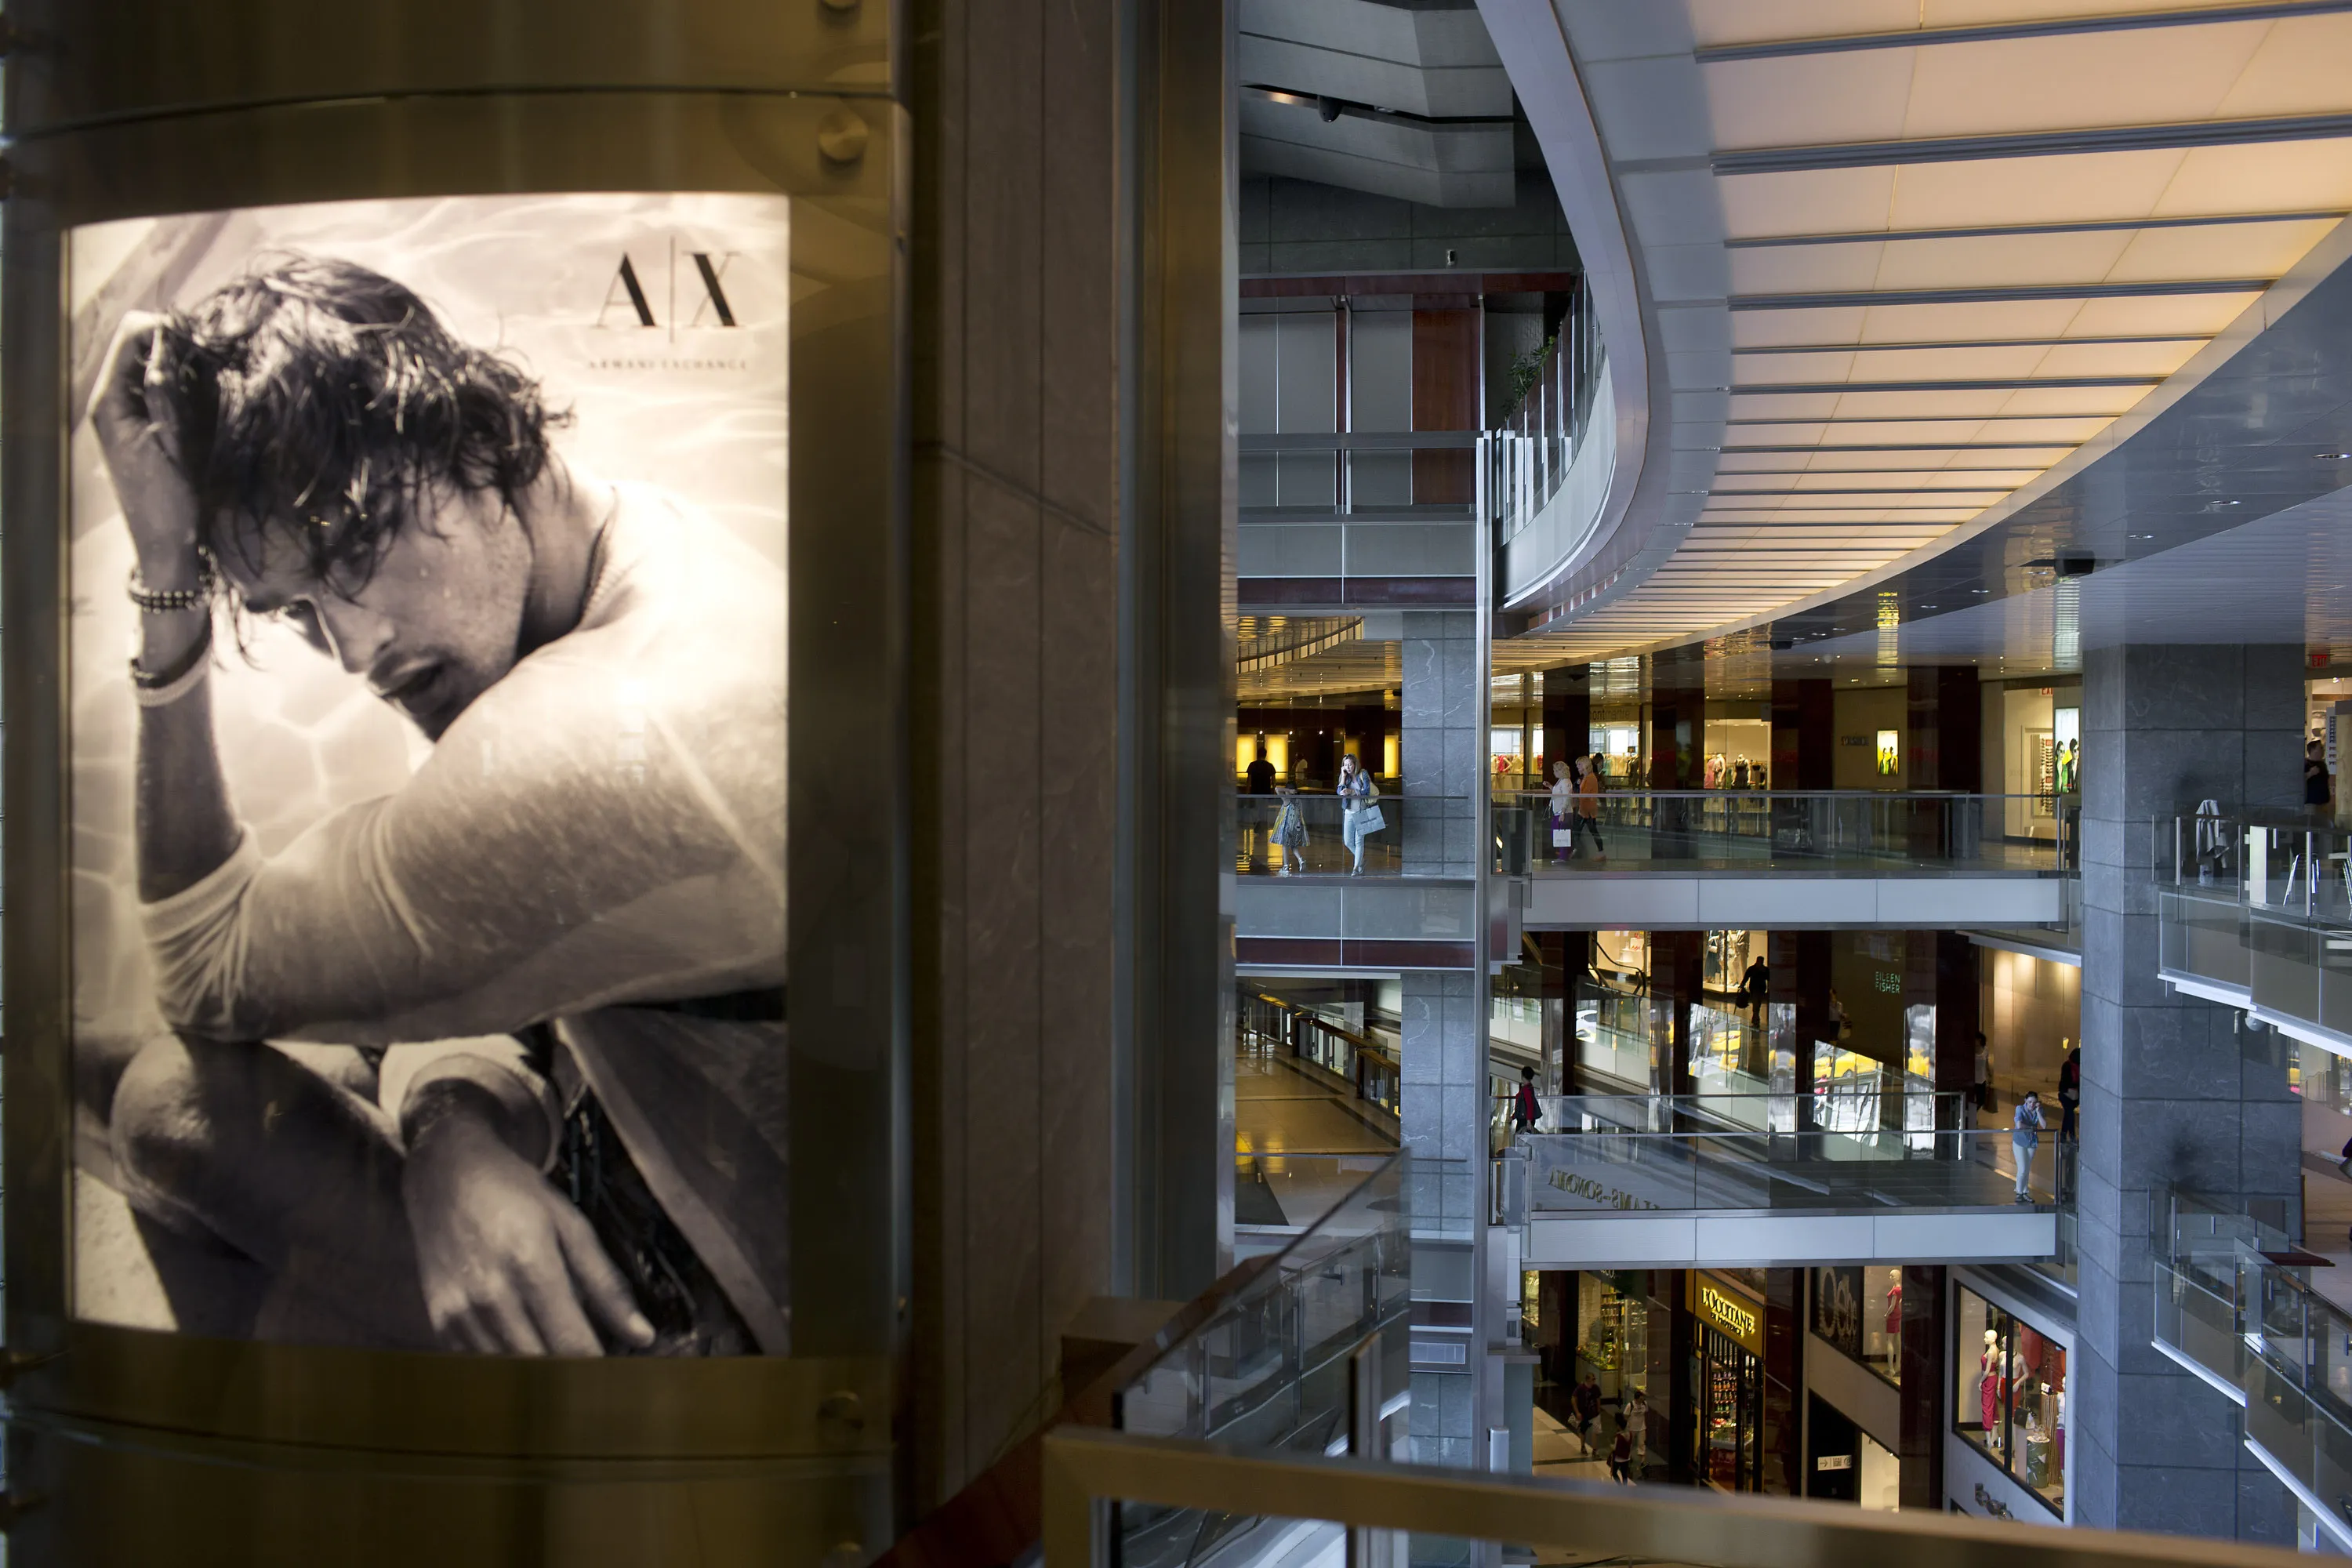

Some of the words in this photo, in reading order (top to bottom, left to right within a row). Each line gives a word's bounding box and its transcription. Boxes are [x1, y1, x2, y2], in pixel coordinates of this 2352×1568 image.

[2312, 655, 2328, 667] EXIT
[1875, 971, 1900, 984] EILEEN
[1875, 982, 1900, 993] FISHER
